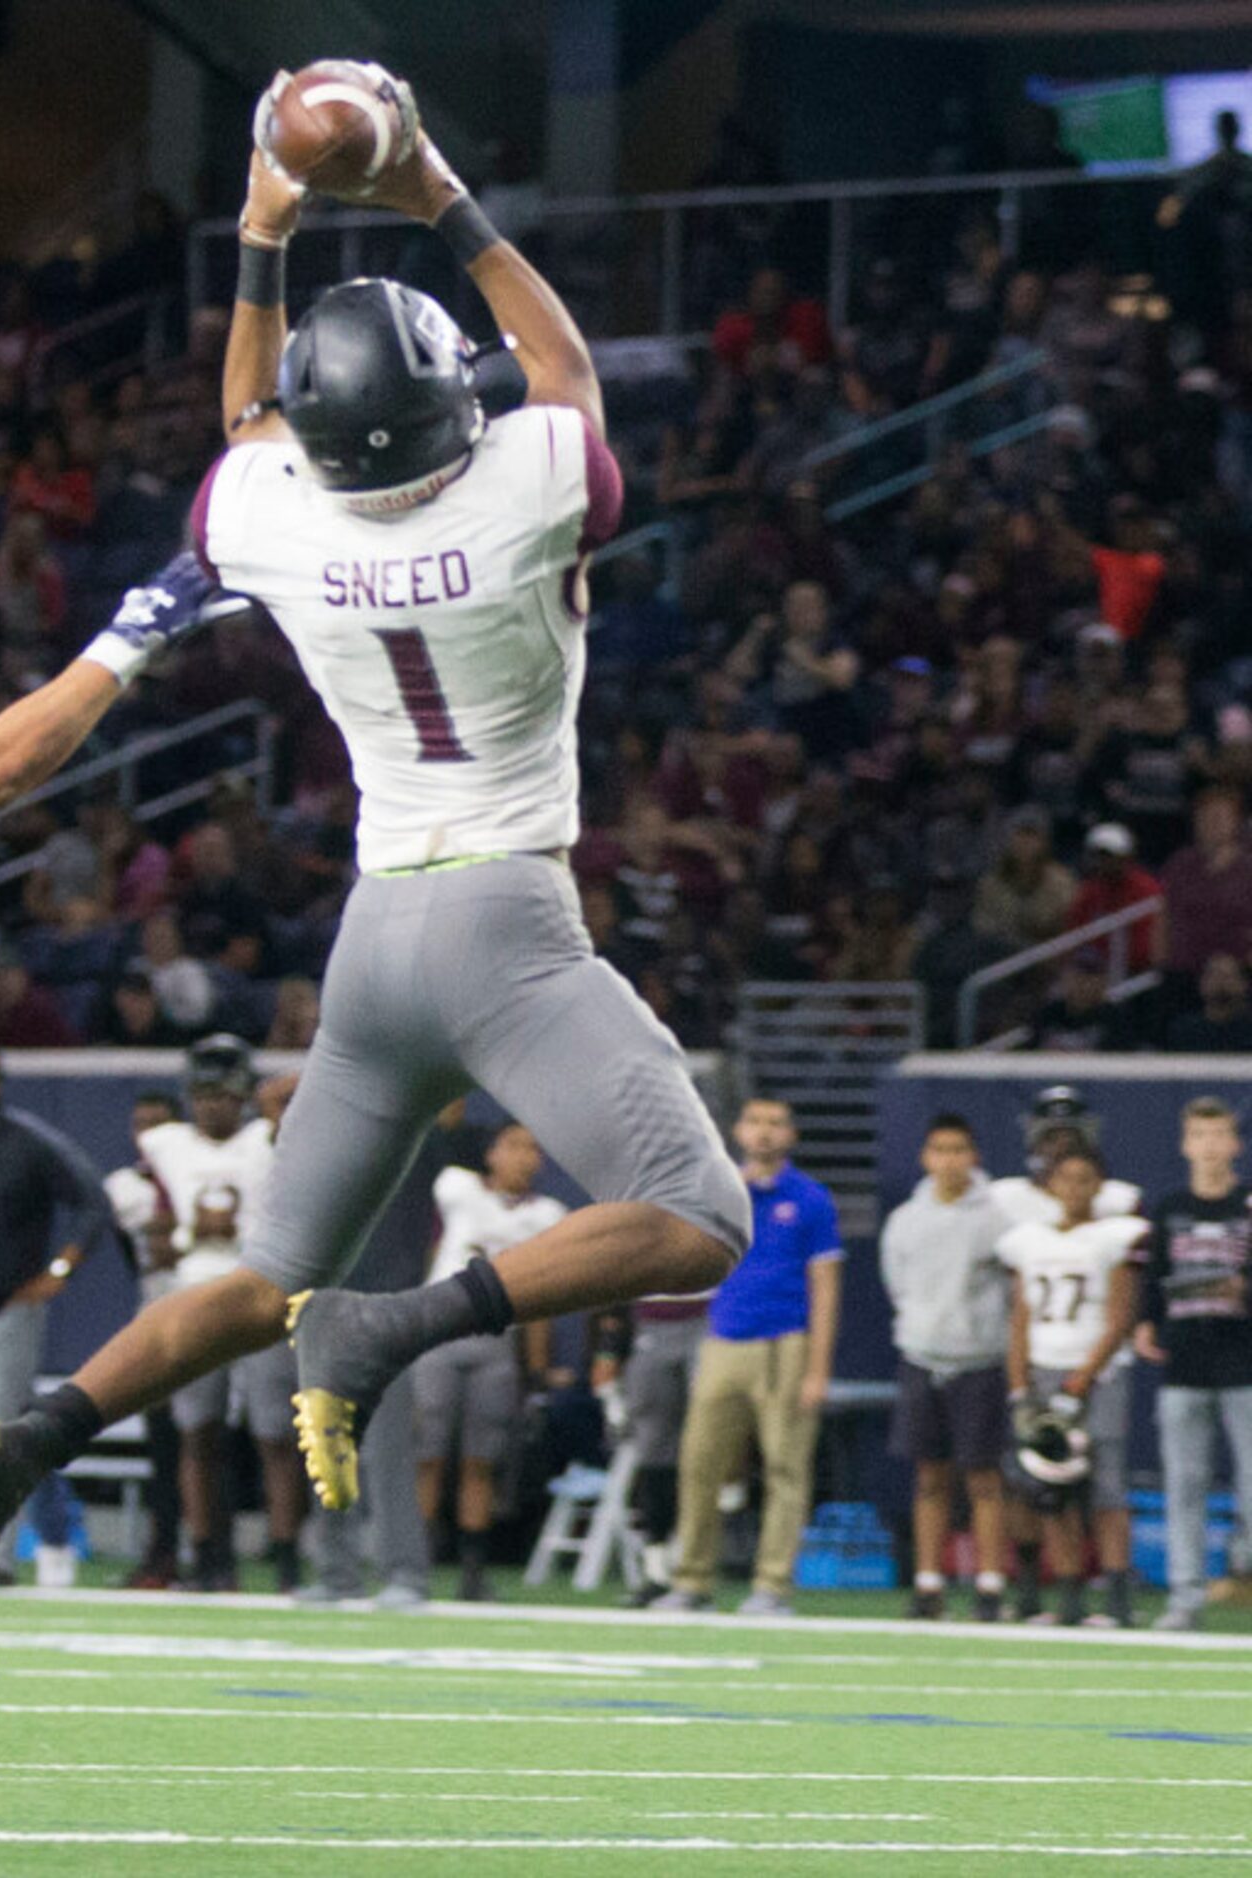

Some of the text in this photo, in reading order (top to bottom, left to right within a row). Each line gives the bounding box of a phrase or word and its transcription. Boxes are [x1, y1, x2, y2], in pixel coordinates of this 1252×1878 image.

[323, 549, 471, 608] SNEED
[367, 624, 478, 763] 1
[1033, 1272, 1087, 1325] 27
